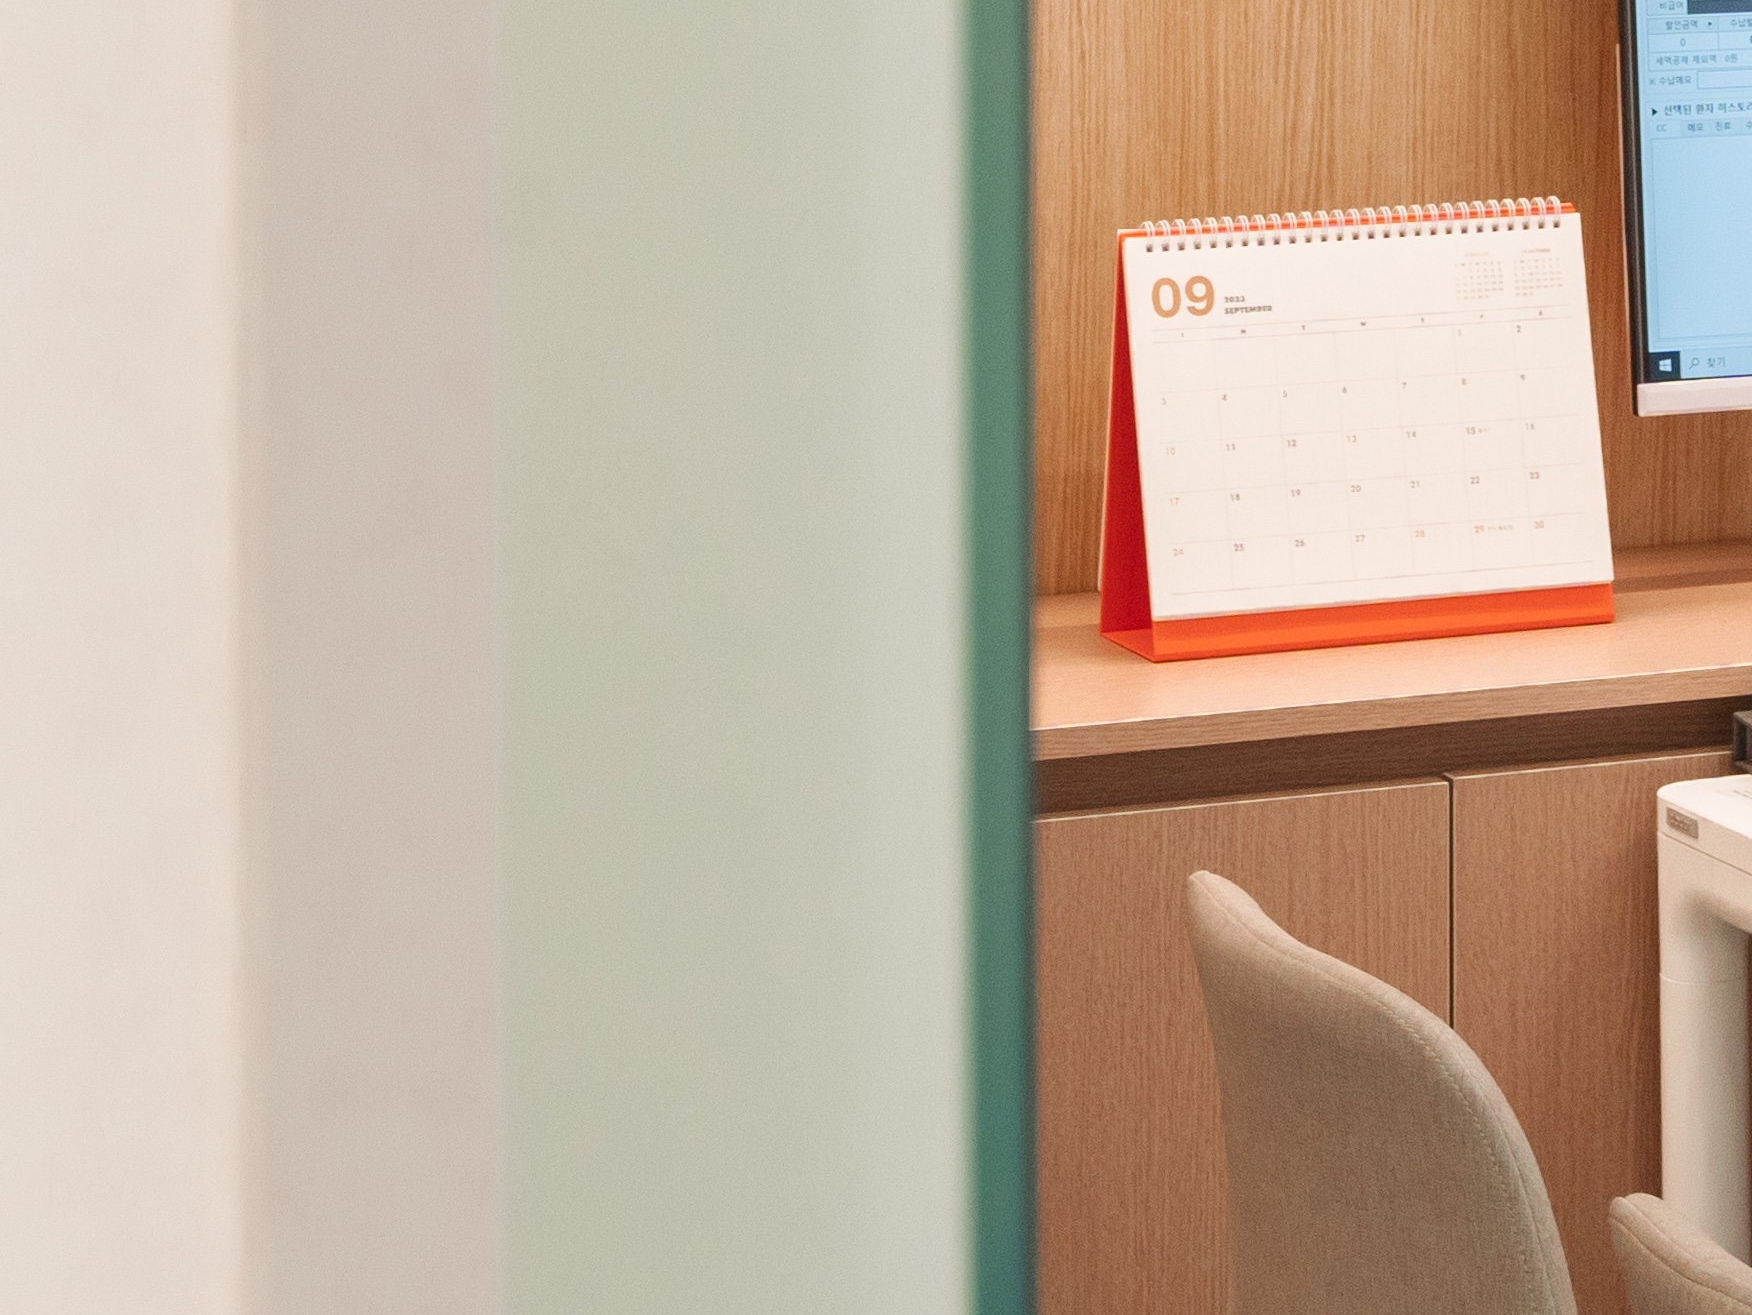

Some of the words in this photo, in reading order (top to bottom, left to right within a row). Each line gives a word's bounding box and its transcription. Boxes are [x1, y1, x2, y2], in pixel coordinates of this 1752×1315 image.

[1664, 105, 1692, 116] 선택된
[1696, 104, 1714, 114] 환자
[1152, 276, 1214, 318] 09
[1225, 306, 1272, 314] SEPTEMBER
[1516, 325, 1521, 333] 2
[1283, 390, 1288, 398] 5
[1226, 443, 1235, 451] 11
[1287, 439, 1297, 447] 12
[1347, 435, 1357, 443] 13
[1466, 427, 1476, 435] 15
[1230, 493, 1240, 501] 18
[1291, 489, 1301, 497] 19
[1351, 485, 1361, 493] 20
[1470, 476, 1480, 484] 22
[1173, 548, 1184, 556] 24
[1234, 543, 1244, 552] 25
[1355, 534, 1365, 542] 27
[1415, 530, 1425, 538] 28
[1474, 525, 1484, 533] 29
[1534, 521, 1544, 529] 30
